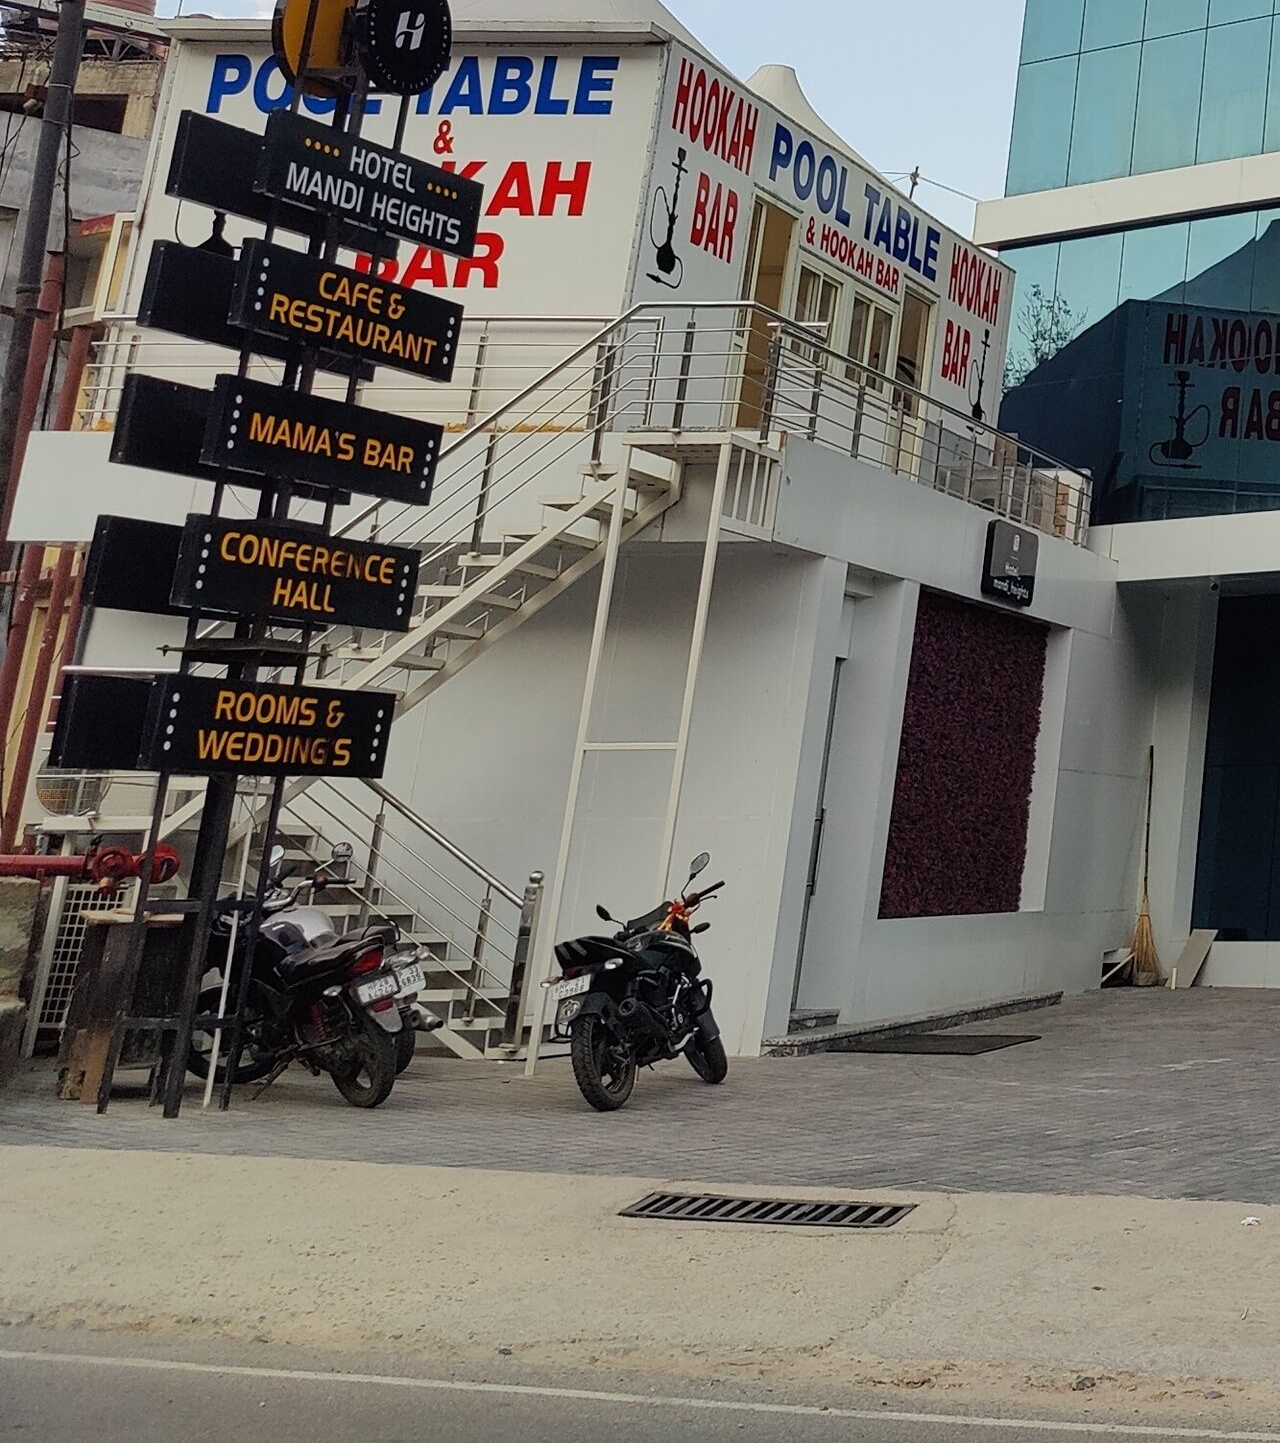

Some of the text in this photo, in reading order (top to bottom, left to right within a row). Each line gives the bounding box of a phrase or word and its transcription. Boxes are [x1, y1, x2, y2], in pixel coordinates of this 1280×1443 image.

[432, 119, 454, 155] &
[671, 57, 759, 176] HOOKAH
[285, 161, 462, 245] MANDI HEIGHTS
[349, 145, 416, 194] HOTEL
[768, 121, 942, 283] POOL TABLE
[689, 172, 739, 265] BAR
[805, 215, 900, 297] & HOOKAH BAR
[947, 241, 1003, 327] HOOKAH
[269, 292, 437, 365] RESTAURANT
[319, 271, 406, 320] CAFE &
[940, 318, 972, 389] BAR
[249, 412, 415, 475] MAMA'S BAR
[220, 531, 396, 585] CONFERENCE
[272, 577, 336, 613] HALL
[214, 690, 345, 729] ROOMS &
